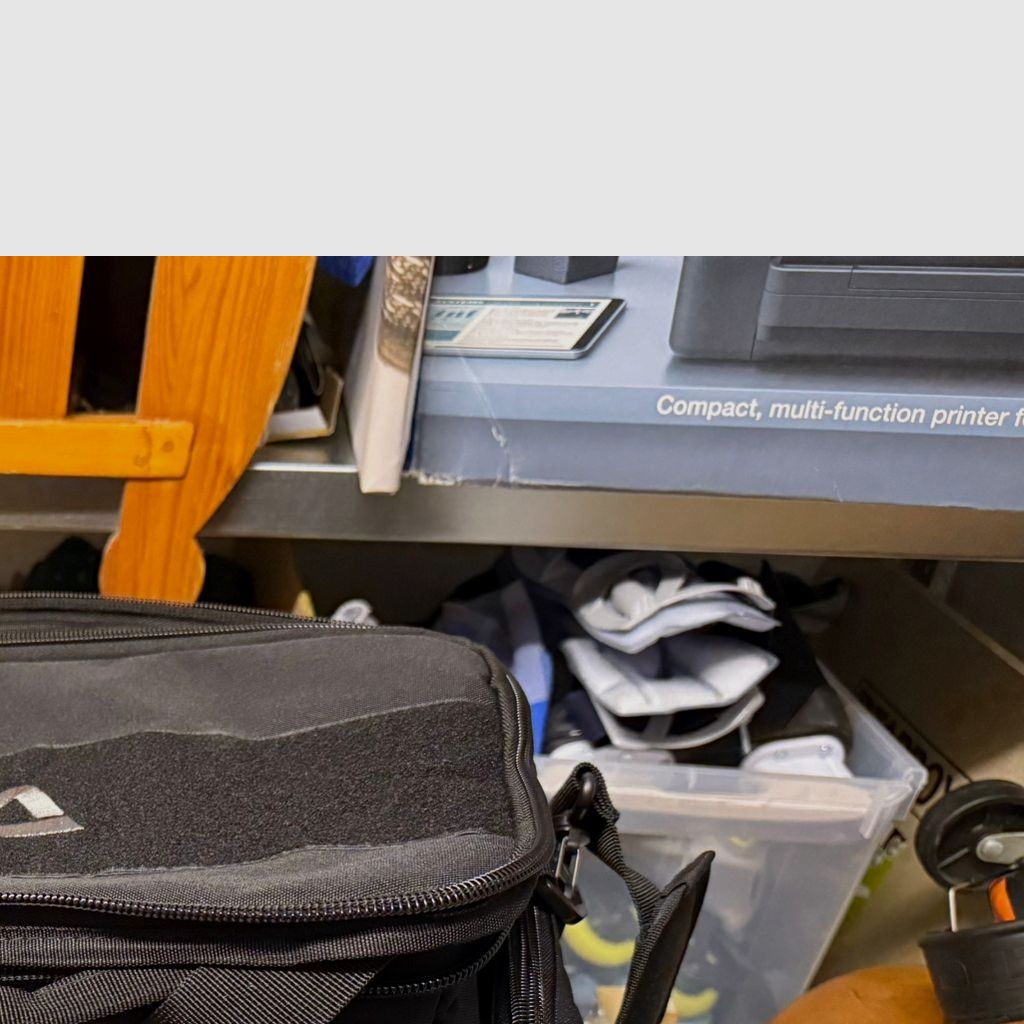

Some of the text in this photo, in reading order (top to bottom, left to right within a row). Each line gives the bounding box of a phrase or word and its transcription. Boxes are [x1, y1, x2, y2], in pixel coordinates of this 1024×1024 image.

[656, 394, 1024, 428] Compact, multi-function printer f
